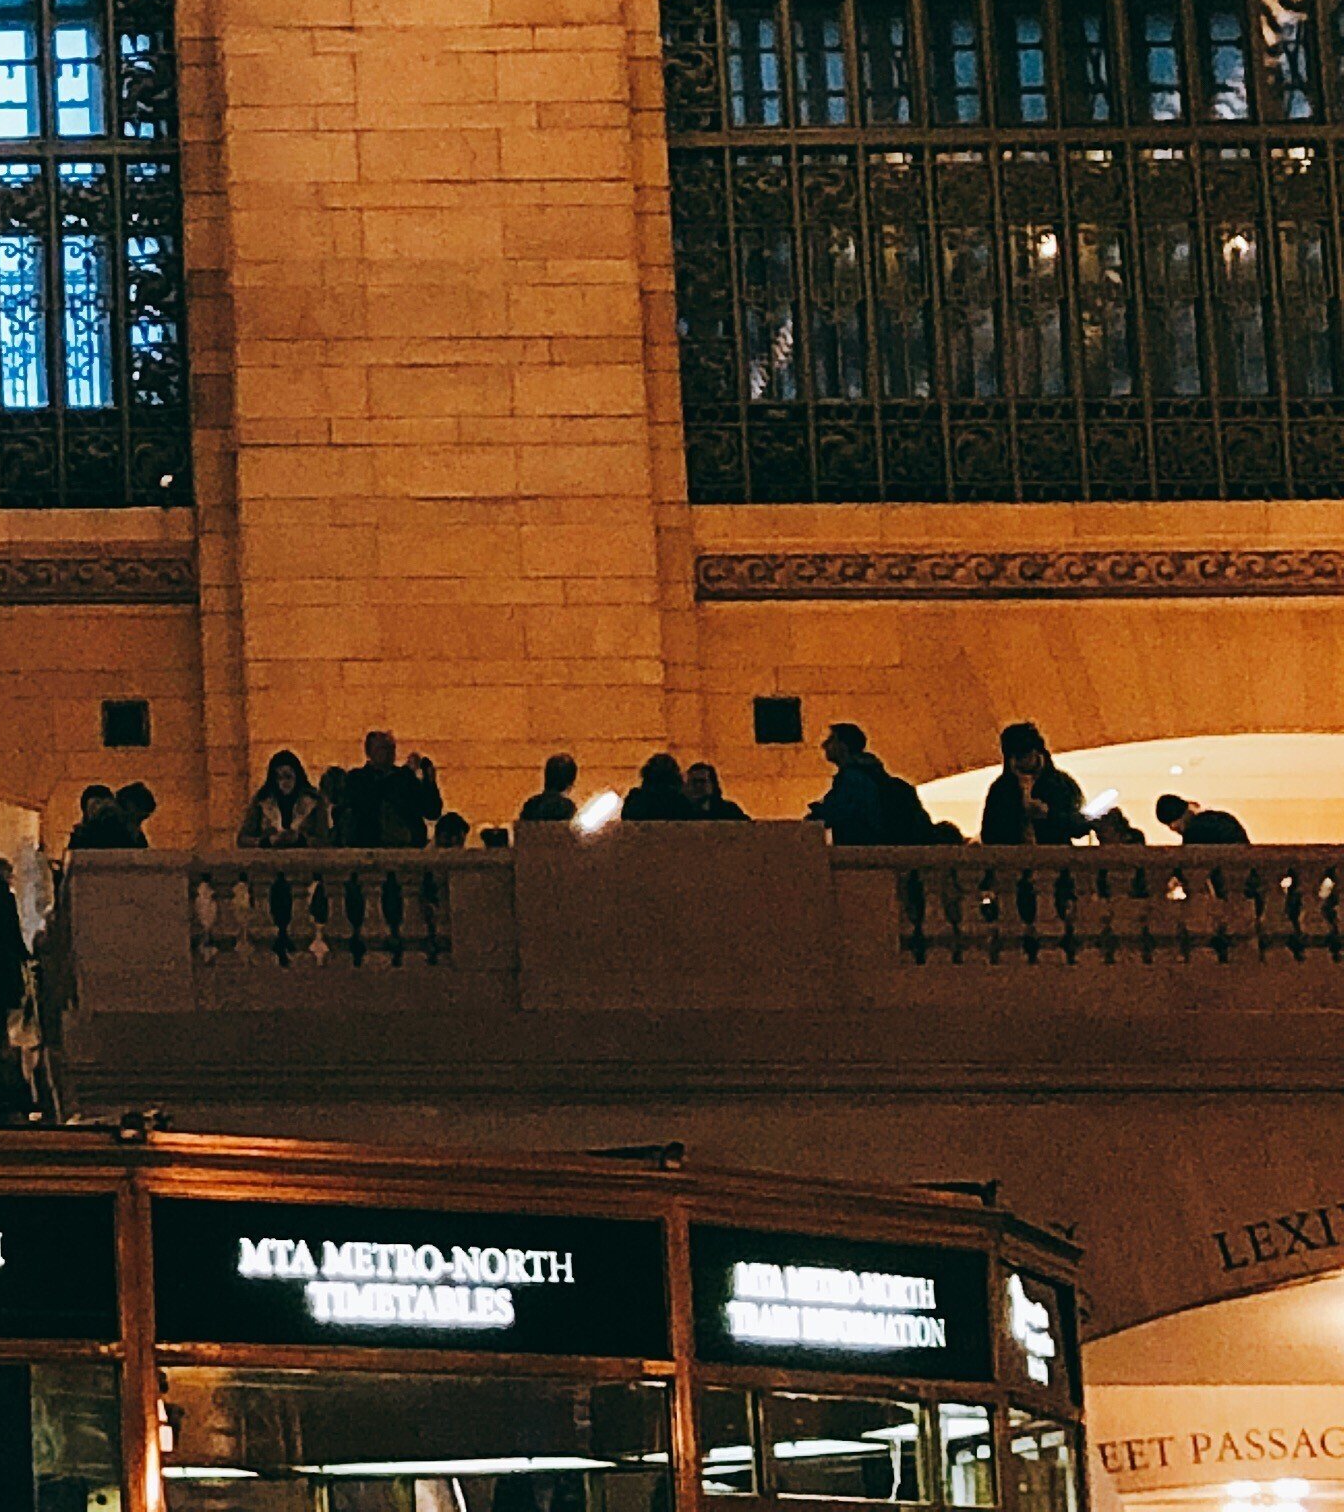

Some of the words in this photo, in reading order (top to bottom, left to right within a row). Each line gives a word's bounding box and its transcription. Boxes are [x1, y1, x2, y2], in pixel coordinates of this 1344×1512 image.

[1214, 1202, 1344, 1273] LEXI
[238, 1238, 316, 1278] MTA
[321, 1242, 575, 1284] METRO-NORTH
[306, 1284, 515, 1327] TIMETABLES
